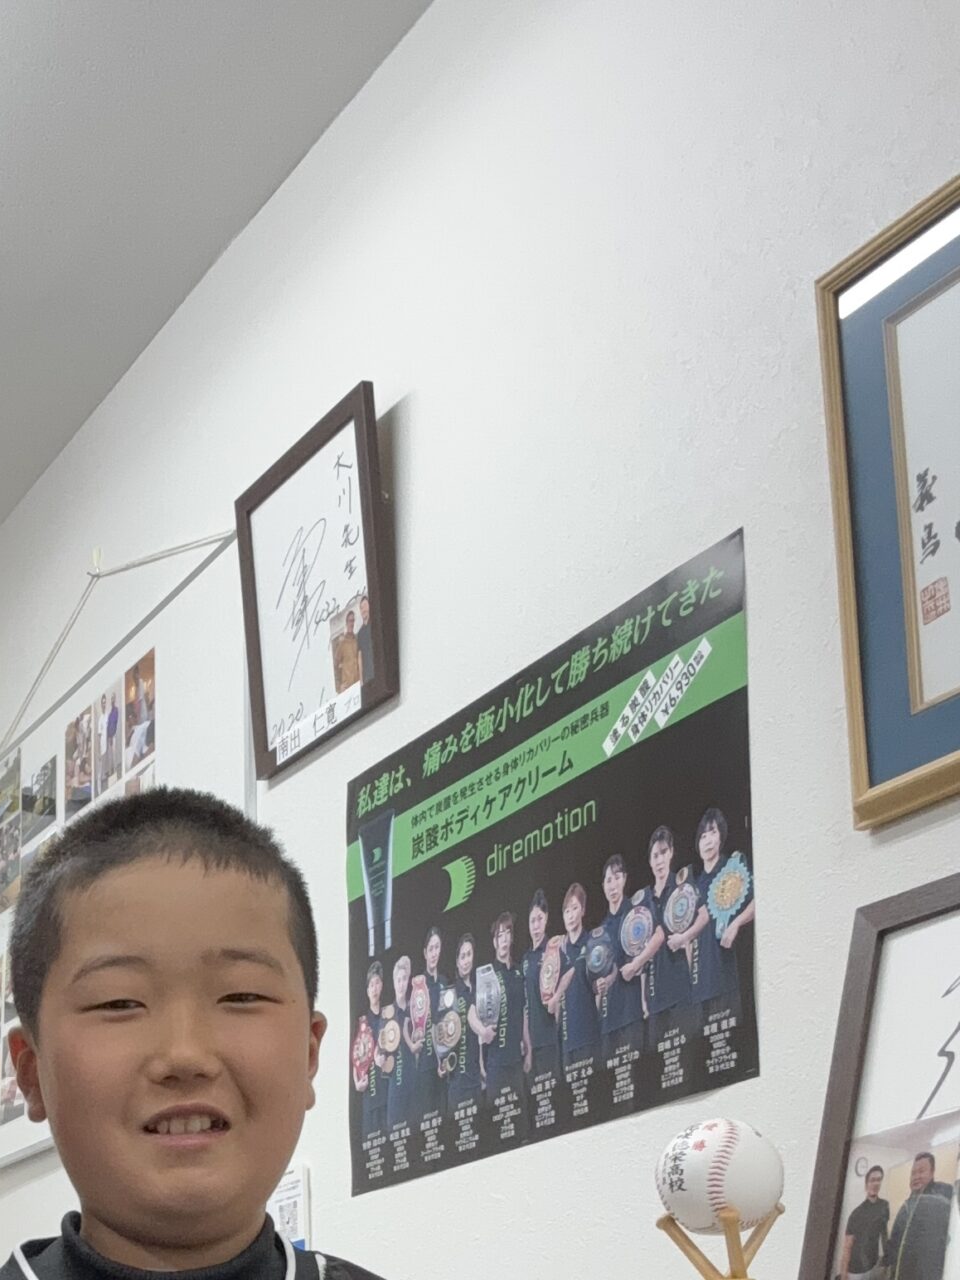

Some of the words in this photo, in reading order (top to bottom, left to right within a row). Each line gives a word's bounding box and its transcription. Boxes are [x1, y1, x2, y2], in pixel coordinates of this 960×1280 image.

[411, 750, 574, 860] 炭酸ボディケアクリーム
[486, 800, 596, 877] diremotion
